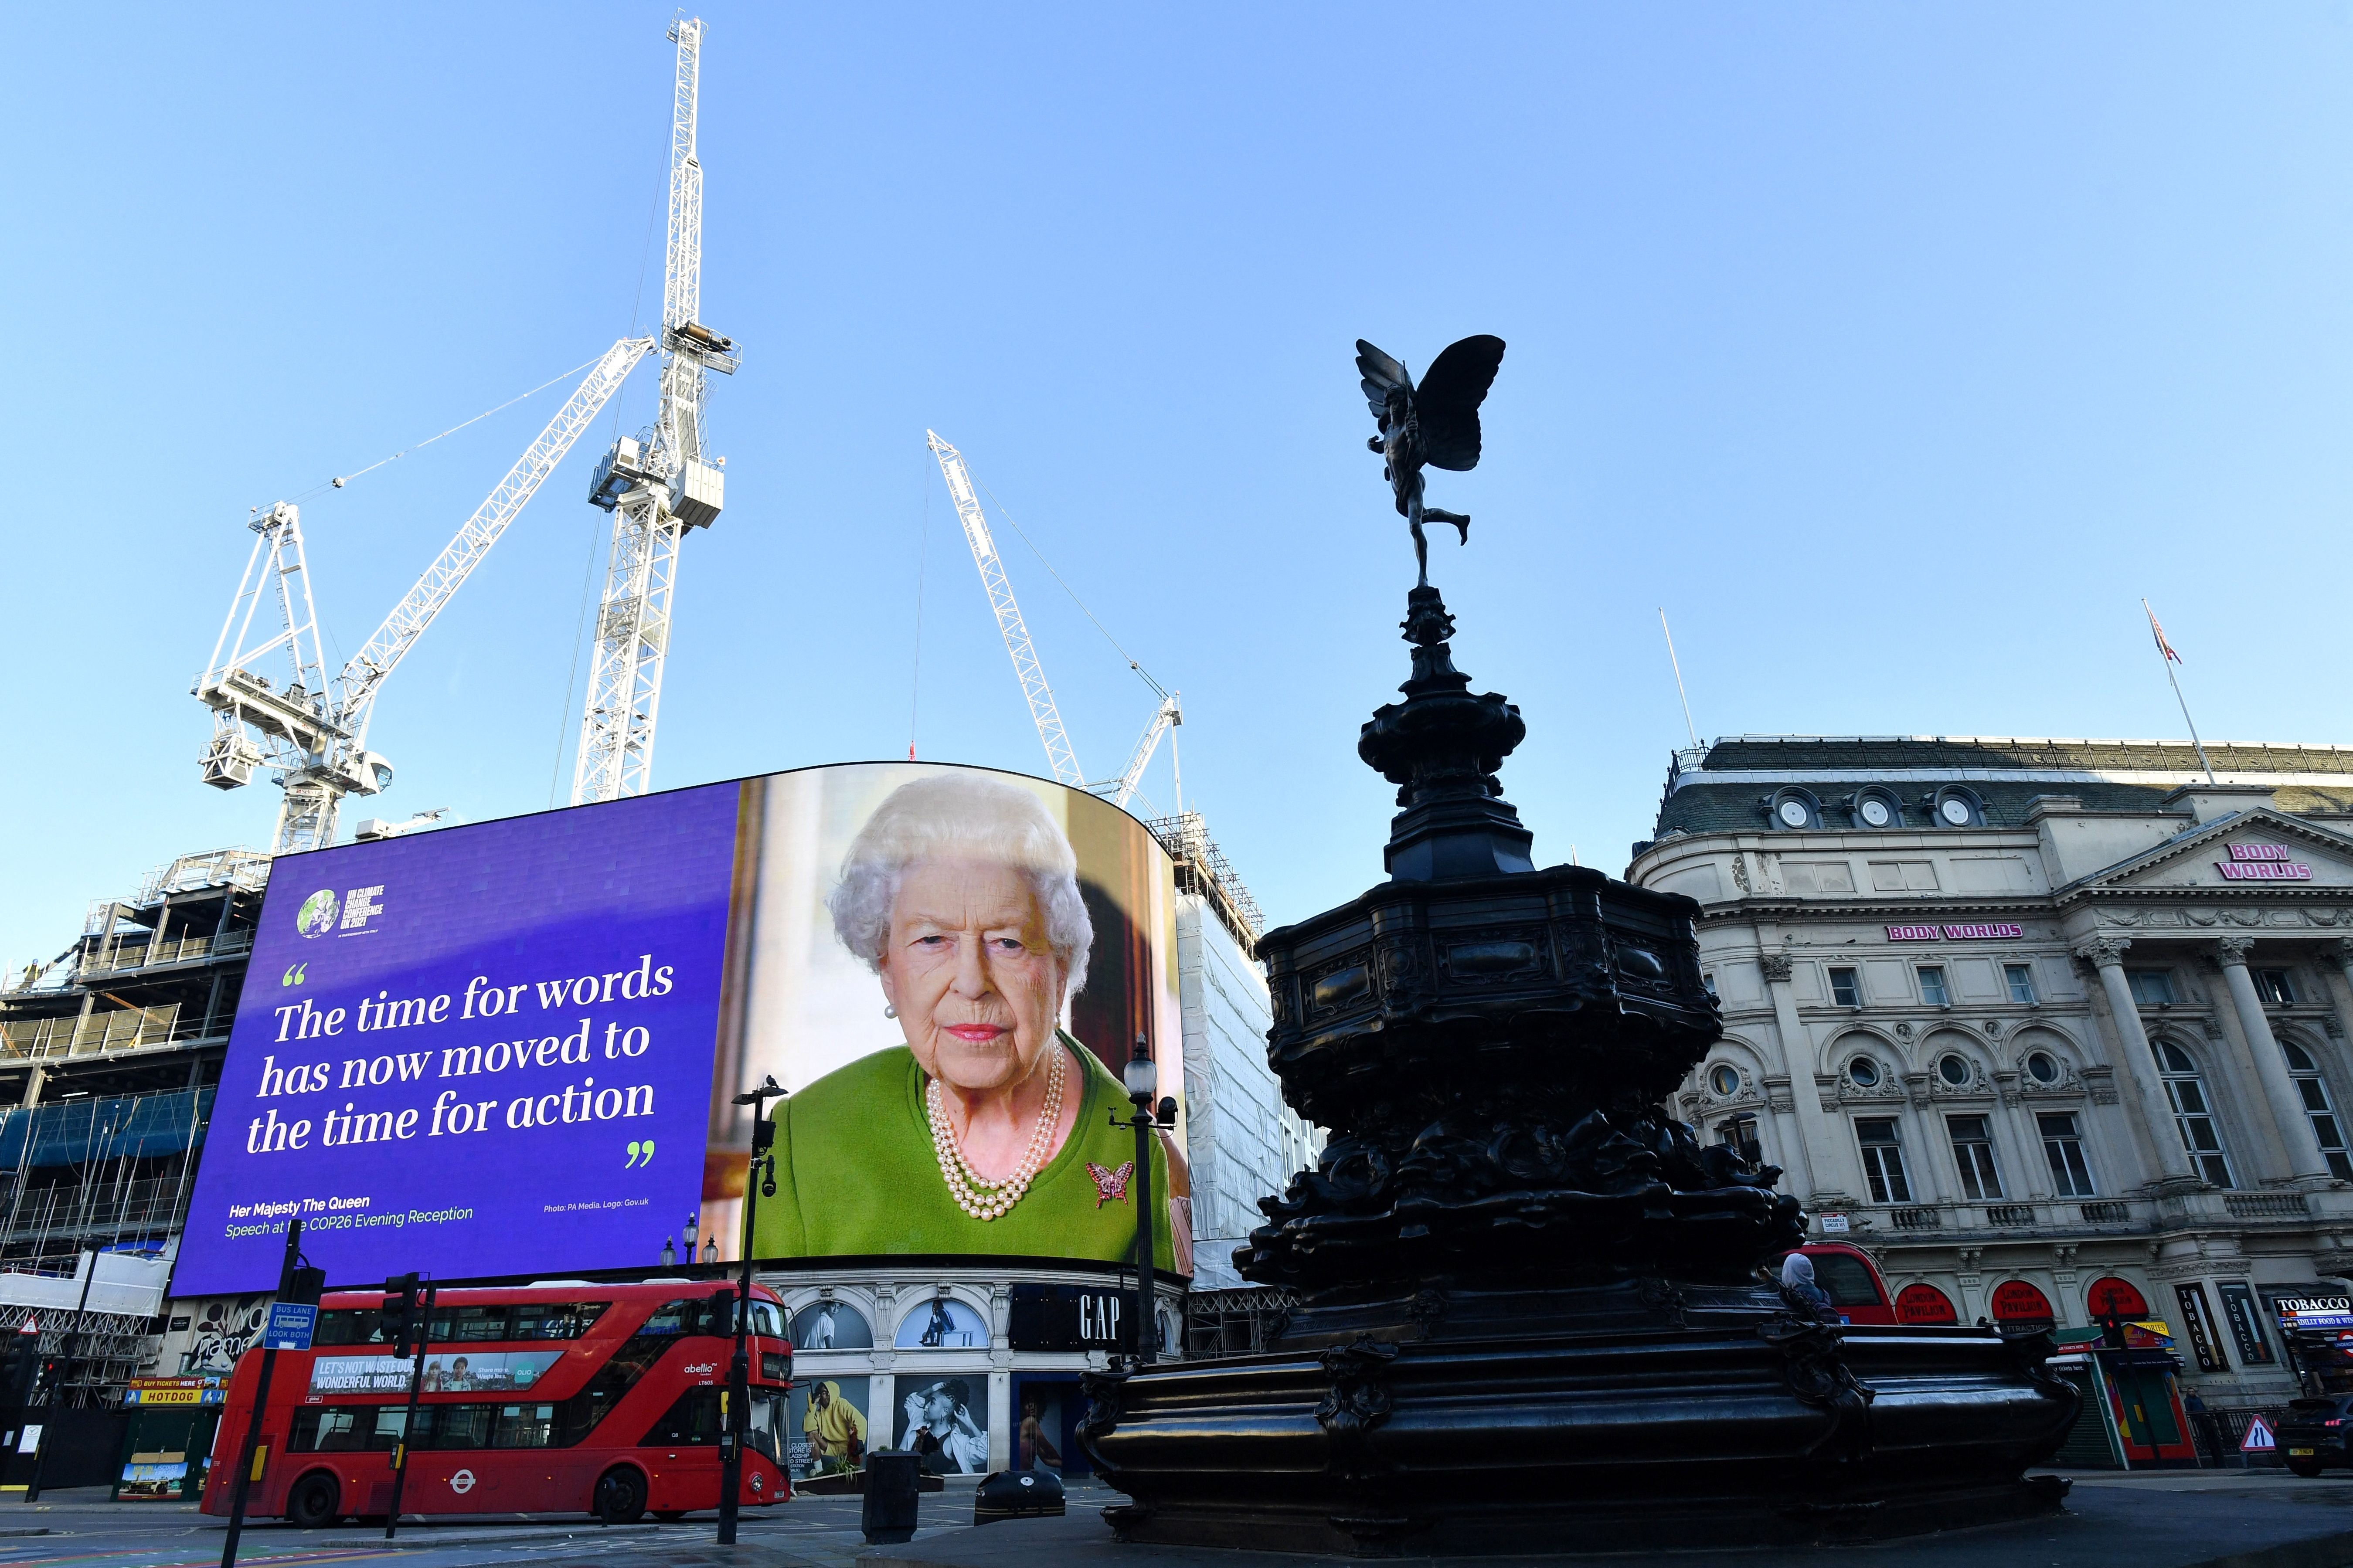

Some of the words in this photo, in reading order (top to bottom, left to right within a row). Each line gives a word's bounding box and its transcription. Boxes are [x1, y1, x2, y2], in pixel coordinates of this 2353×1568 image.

[2228, 844, 2290, 860] BODY
[2218, 863, 2313, 879] WORLDS
[347, 889, 357, 899] UN
[357, 885, 384, 897] CLIMATE
[345, 896, 371, 910] CHANGE
[343, 904, 384, 920] CONFERENCE
[340, 919, 351, 930] UK
[350, 916, 367, 928] 2021
[1888, 926, 1940, 940] BODY
[1943, 923, 2023, 938] WORLDS
[275, 999, 345, 1042] The
[358, 991, 450, 1032] time
[460, 976, 527, 1019] for
[536, 954, 673, 1009] words
[256, 1056, 330, 1097] has
[339, 1052, 432, 1088] now
[439, 1018, 590, 1077] moved
[605, 1022, 649, 1059] to
[248, 1109, 311, 1153] the
[323, 1103, 418, 1146] time
[428, 1091, 497, 1136] for
[507, 1077, 654, 1128] action
[229, 1205, 252, 1218] Her
[253, 1201, 301, 1219] Majesty
[303, 1198, 325, 1212] The
[328, 1196, 370, 1211] Queen
[544, 1205, 566, 1213] Photo:
[603, 1201, 623, 1209] Logo:
[624, 1198, 649, 1206] Gov.uk
[225, 1222, 269, 1240] Speech
[272, 1223, 285, 1234] at
[309, 1215, 352, 1230] COP26
[355, 1212, 405, 1228] Evening
[408, 1206, 473, 1224] Reception
[1905, 1293, 1937, 1303] LONDON
[2003, 1288, 2034, 1299] LONDON
[1902, 1304, 1946, 1318] PAVILION
[2000, 1300, 2044, 1315] PAVILION
[2278, 1297, 2350, 1311] TOBACCO
[1080, 1294, 1119, 1340] GAP
[2180, 1290, 2210, 1366] TOBACCO
[2226, 1294, 2254, 1360] TOBACCO
[319, 1361, 345, 1374] LET'S
[345, 1361, 365, 1373] NOT
[365, 1361, 396, 1373] WASTE
[397, 1360, 415, 1373] OUR
[684, 1363, 713, 1373] abellio
[316, 1375, 371, 1389] WONDERFUL
[373, 1375, 407, 1388] WORLD.
[148, 1392, 194, 1402] HOTDOG
